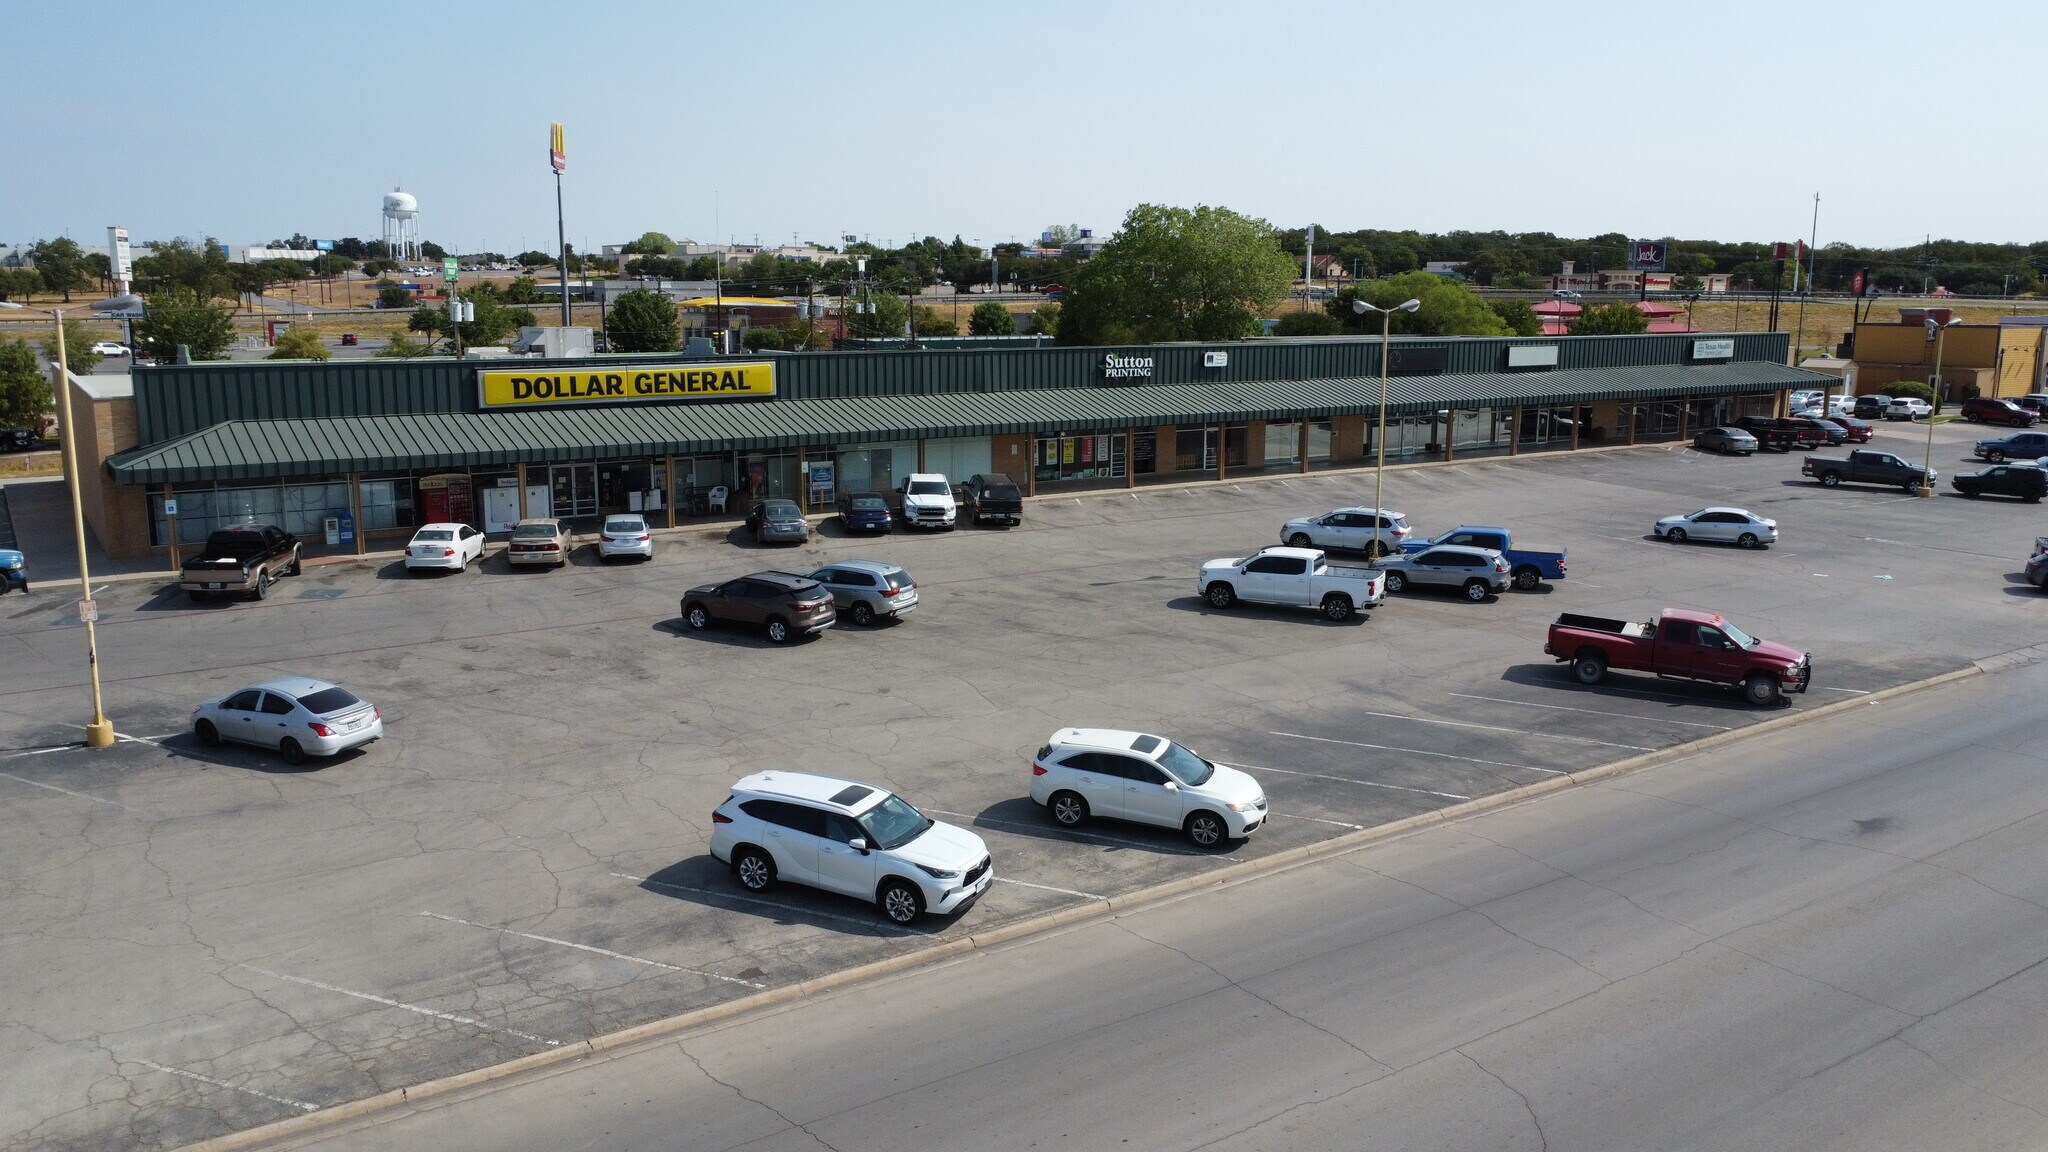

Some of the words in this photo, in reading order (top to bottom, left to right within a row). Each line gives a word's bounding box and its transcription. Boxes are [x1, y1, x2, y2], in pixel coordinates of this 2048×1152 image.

[1637, 246, 1662, 262] Jack
[1106, 354, 1153, 368] Sutton
[1105, 368, 1151, 377] PRINTING
[511, 374, 624, 400] DOLLAR
[635, 369, 751, 394] GENERAL
